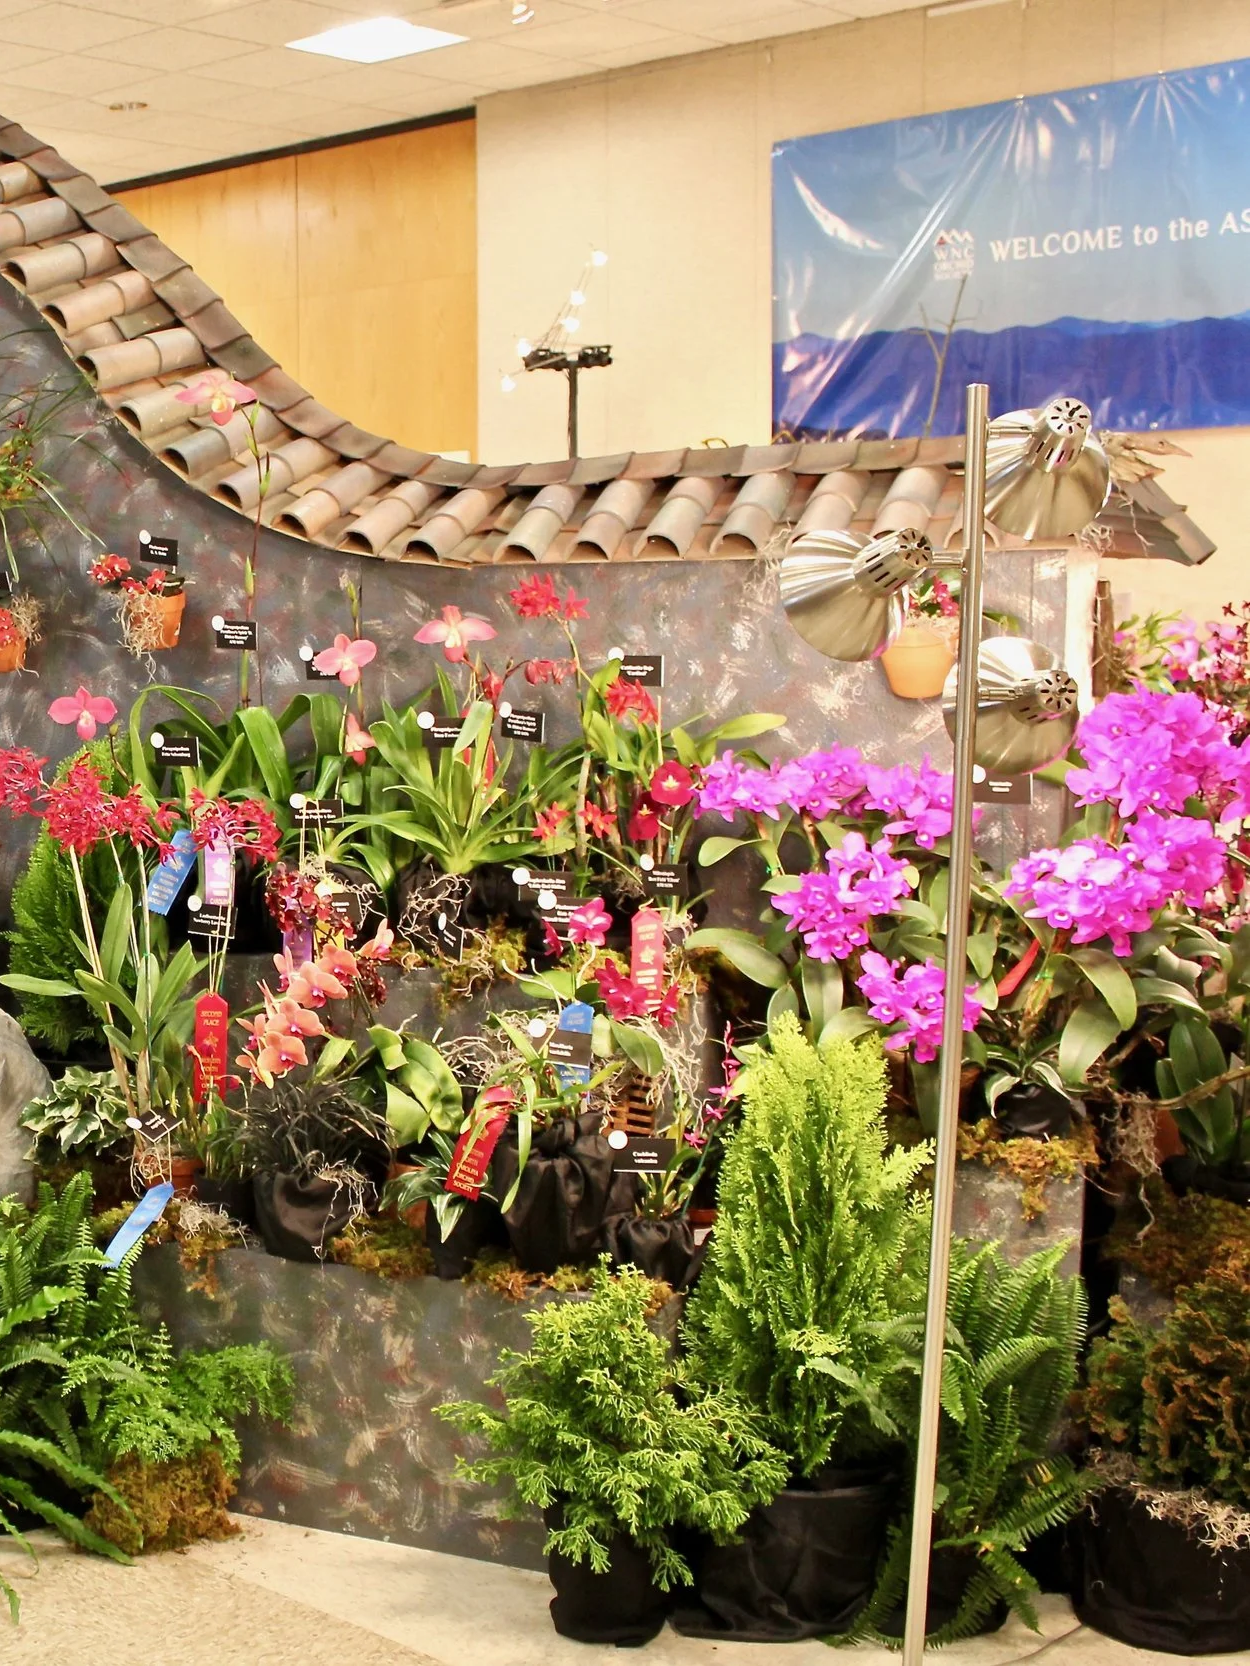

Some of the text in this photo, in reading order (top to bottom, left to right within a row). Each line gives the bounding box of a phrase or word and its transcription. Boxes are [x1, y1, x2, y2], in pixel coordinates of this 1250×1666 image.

[988, 224, 1124, 263] WELCOME
[1132, 223, 1159, 247] to
[1168, 216, 1210, 242] the
[933, 247, 975, 261] WNC
[453, 1180, 474, 1193] SOCIETY
